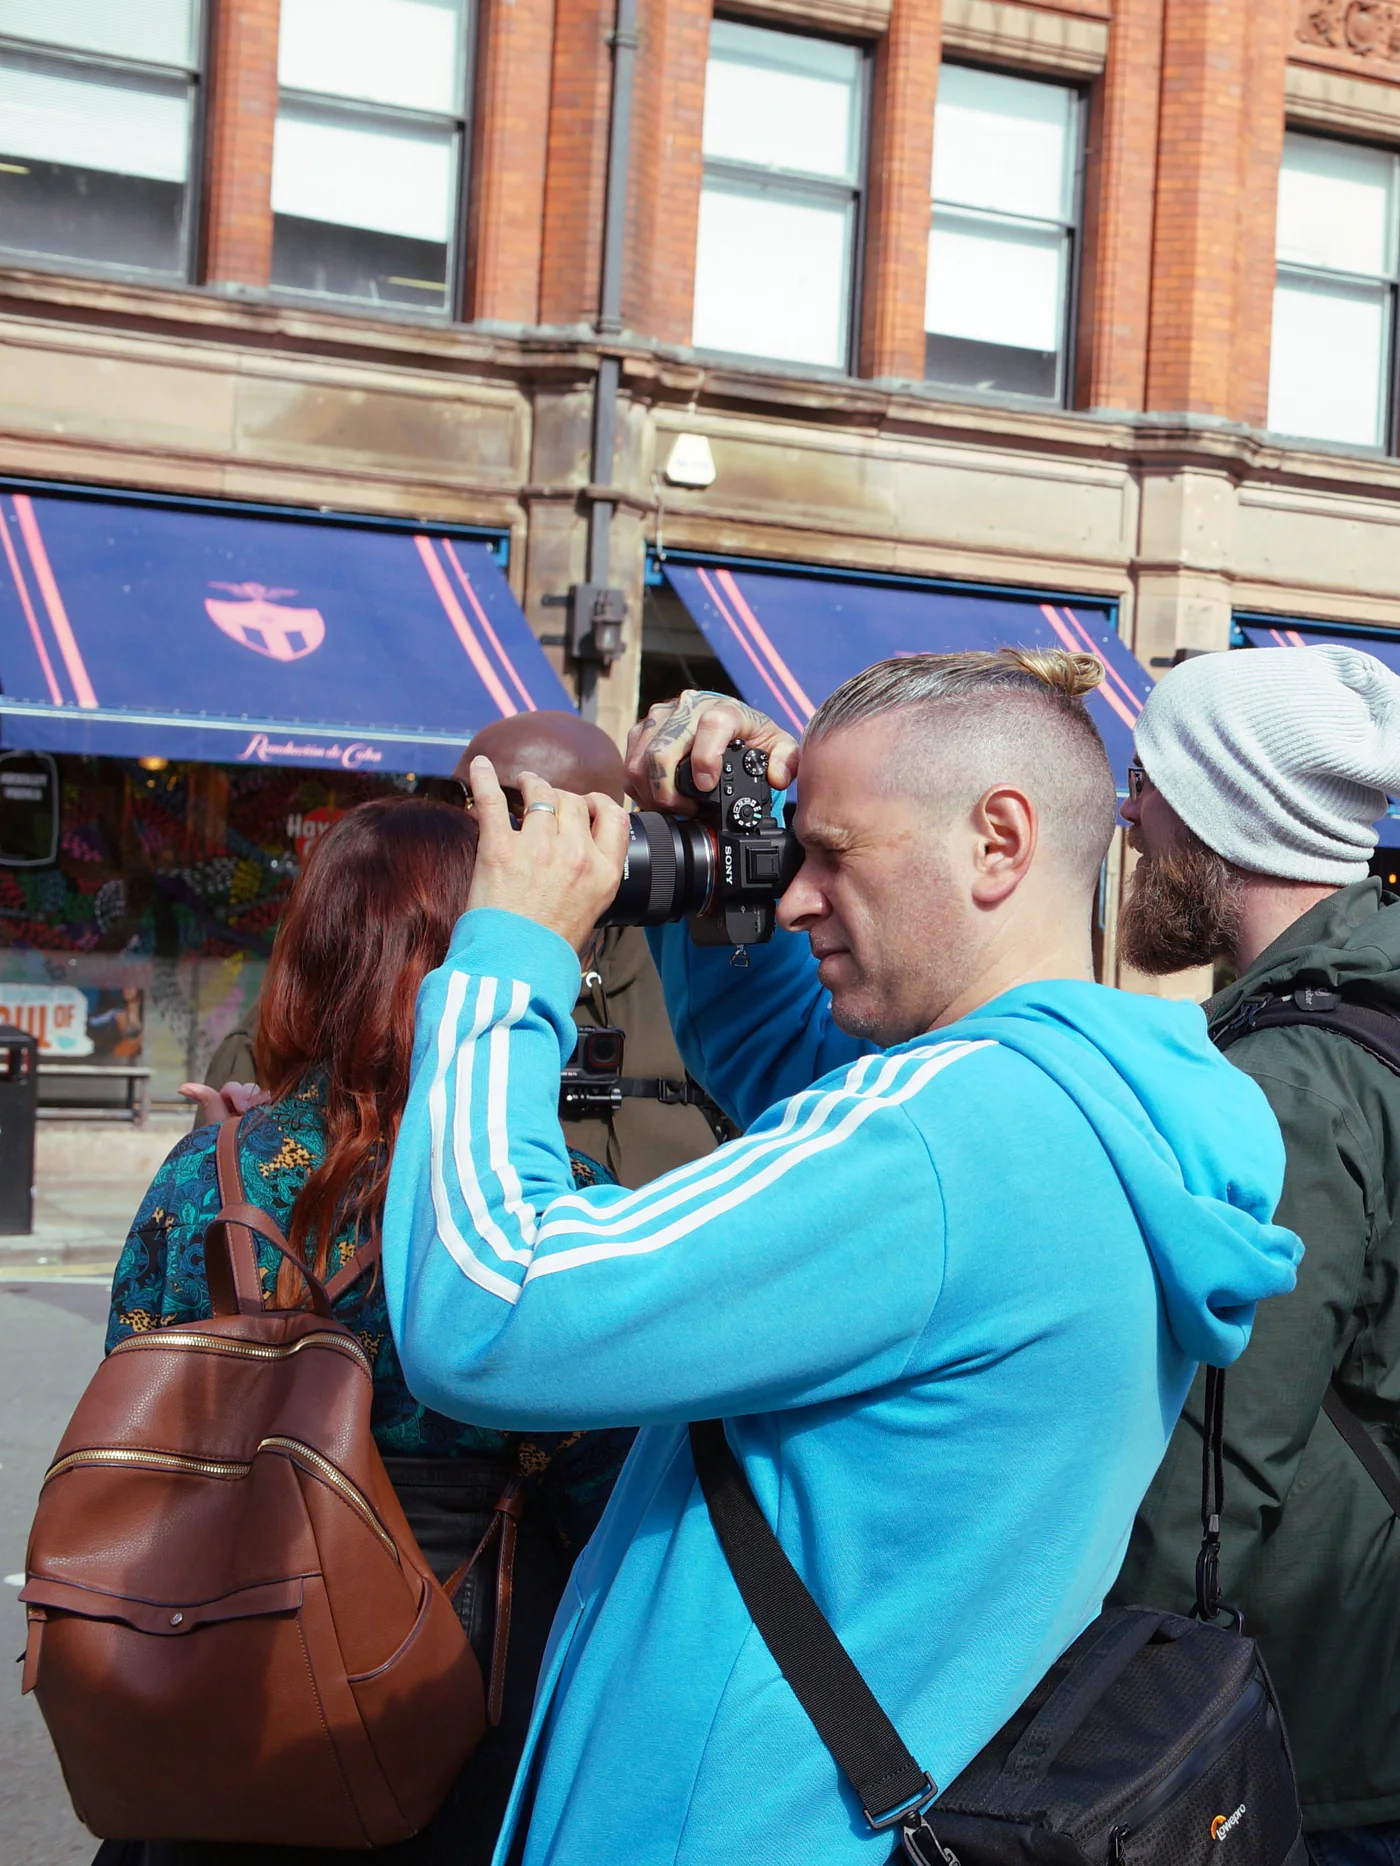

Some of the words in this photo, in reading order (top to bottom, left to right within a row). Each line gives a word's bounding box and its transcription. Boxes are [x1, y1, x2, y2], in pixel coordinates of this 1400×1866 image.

[724, 845, 733, 885] SONY
[54, 1004, 76, 1029] OF
[1216, 1803, 1246, 1841] Lowepro
